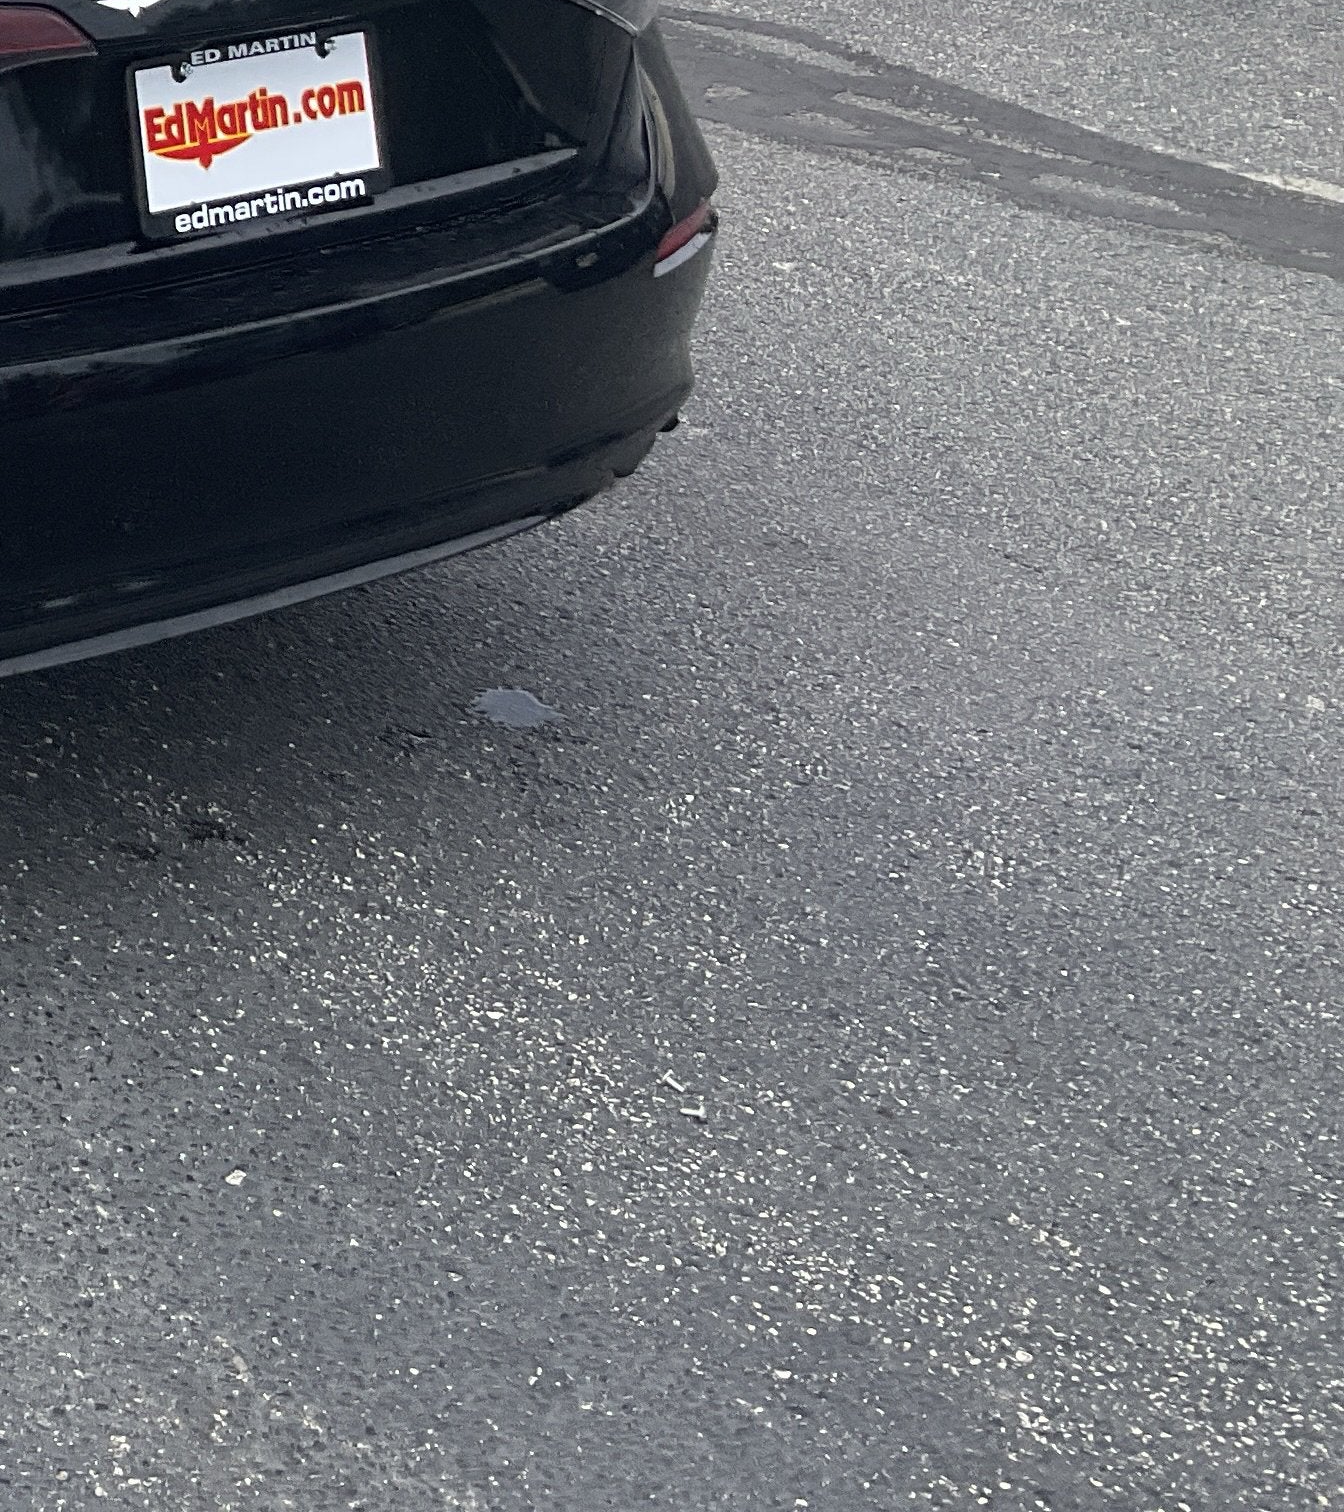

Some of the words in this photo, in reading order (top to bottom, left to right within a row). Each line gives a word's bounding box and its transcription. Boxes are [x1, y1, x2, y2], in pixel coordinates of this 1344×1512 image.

[190, 49, 221, 66] ED
[227, 31, 317, 60] MARTIN
[144, 79, 365, 154] EdMartin.com
[174, 177, 366, 233] edmartin.com
